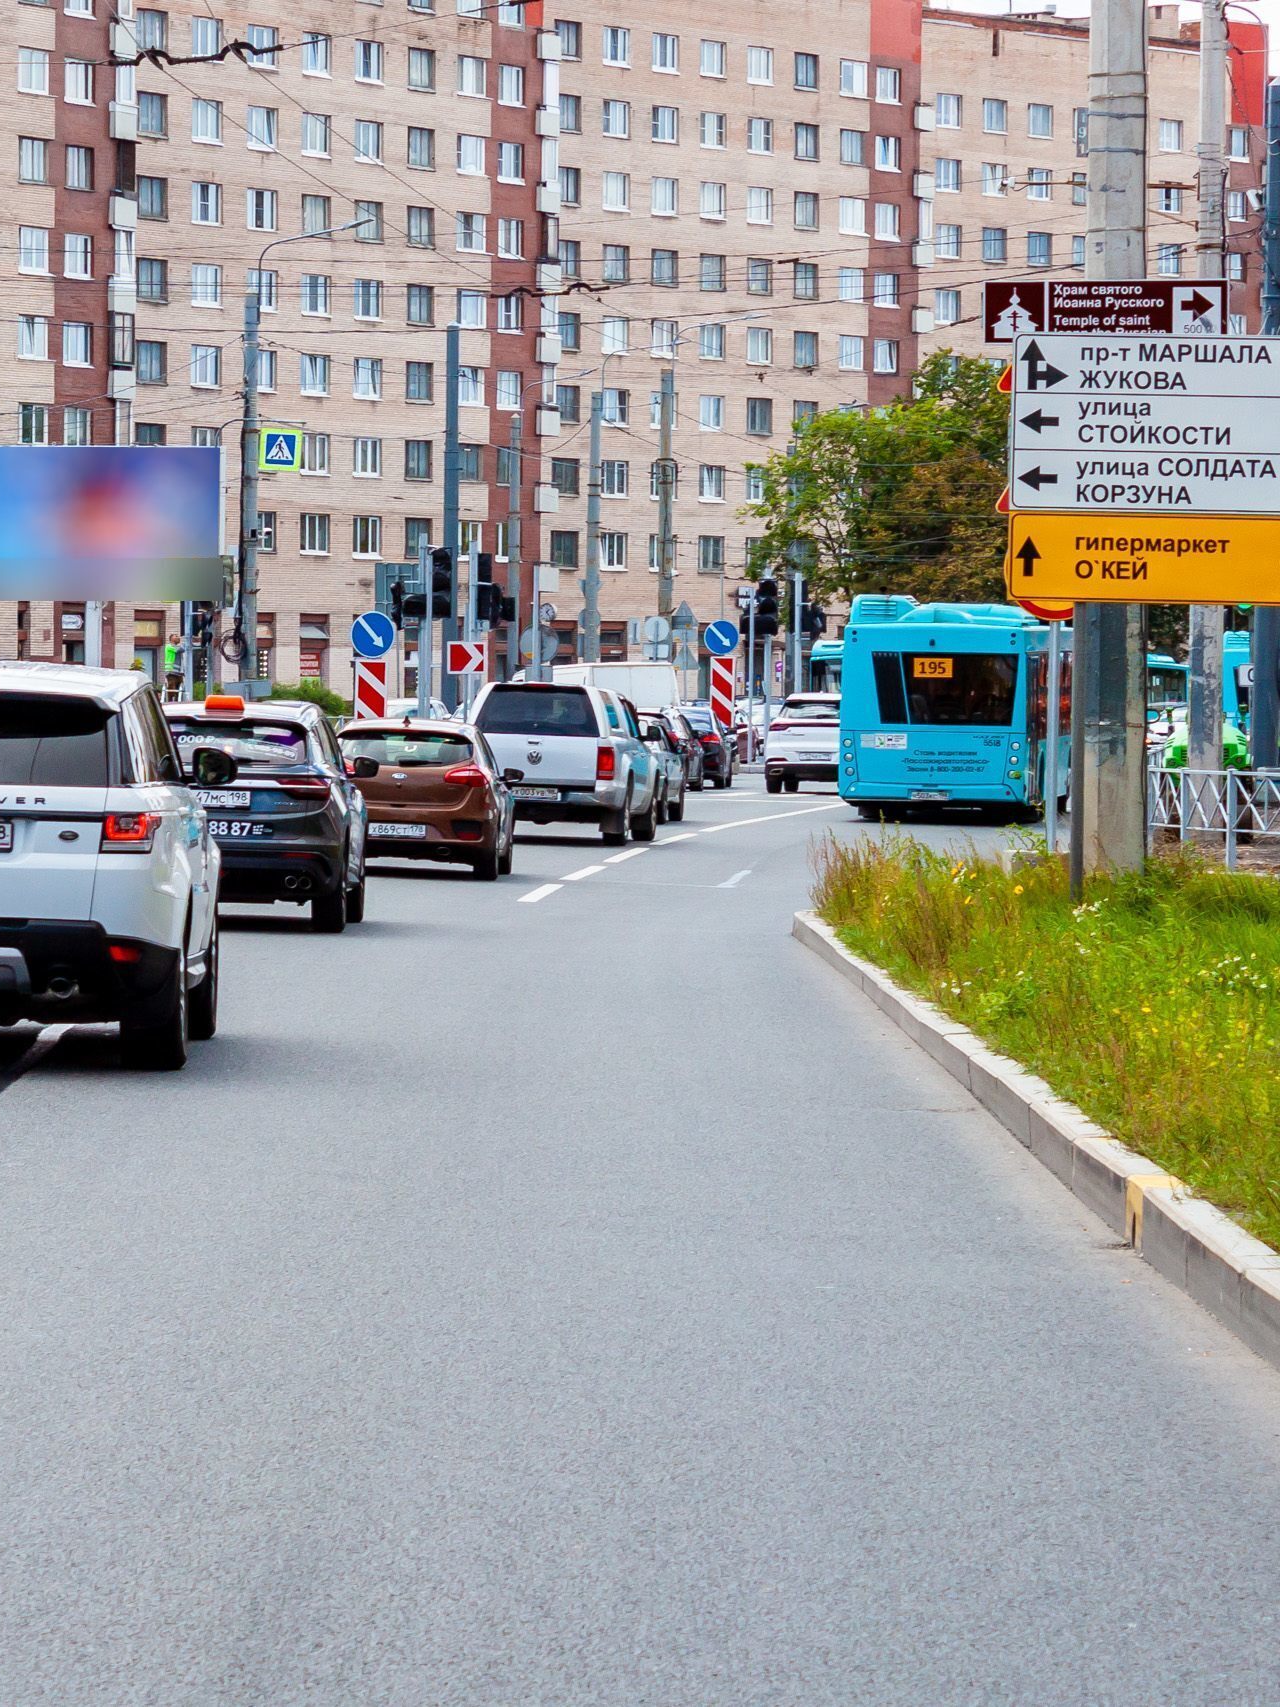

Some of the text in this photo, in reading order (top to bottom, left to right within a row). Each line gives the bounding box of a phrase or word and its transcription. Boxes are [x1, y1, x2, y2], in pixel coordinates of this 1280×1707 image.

[1053, 284, 1143, 297] Храм святого
[1053, 296, 1165, 310] Иоанна Русского
[1053, 314, 1151, 328] Temple of saint
[1184, 325, 1203, 334] 500
[1080, 343, 1272, 365] пр-т МАРШАЛА
[1079, 369, 1187, 390] ЖУКОВА
[1078, 401, 1151, 419] улица
[1078, 420, 1231, 445] СТОЙКОСТИ
[1076, 457, 1277, 481] улица СОЛДАТА
[1076, 484, 1192, 504] КОРЗУНА
[1075, 536, 1230, 557] гипермаркет
[918, 661, 946, 674] 195
[229, 792, 248, 802] 198
